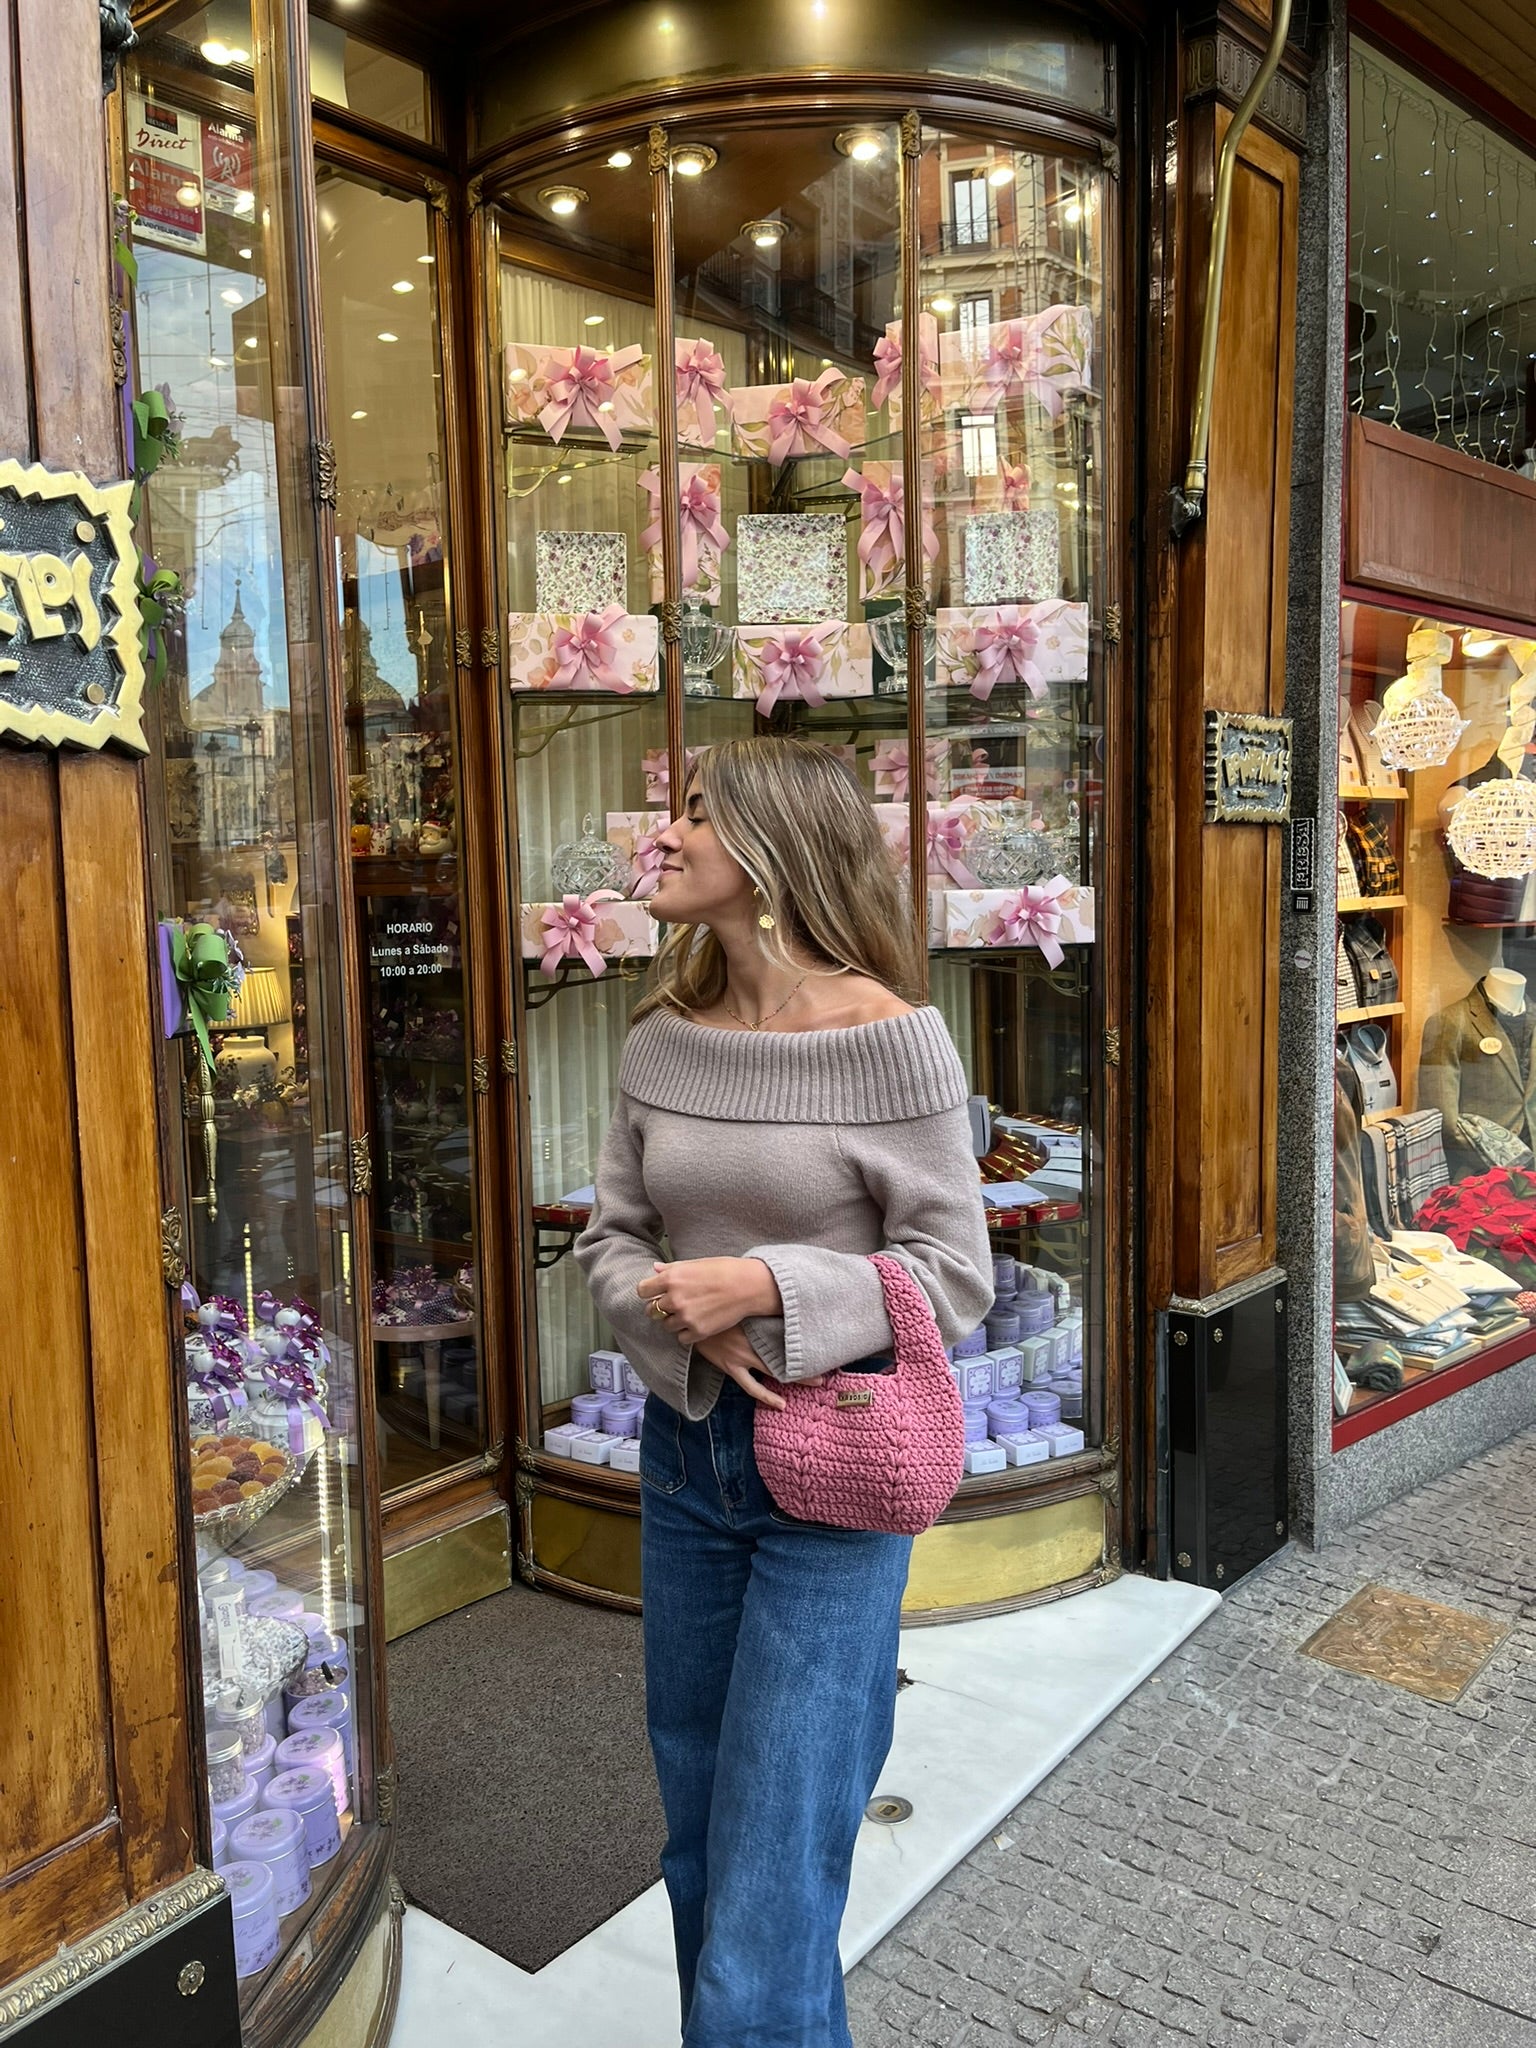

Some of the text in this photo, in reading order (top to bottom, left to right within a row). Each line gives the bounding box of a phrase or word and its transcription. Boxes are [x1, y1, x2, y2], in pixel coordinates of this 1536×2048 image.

[136, 128, 193, 150] Direct
[386, 922, 433, 934] HORARIO
[371, 943, 449, 957] Lunes a Sábado
[380, 963, 443, 977] 10:00 a 20:00
